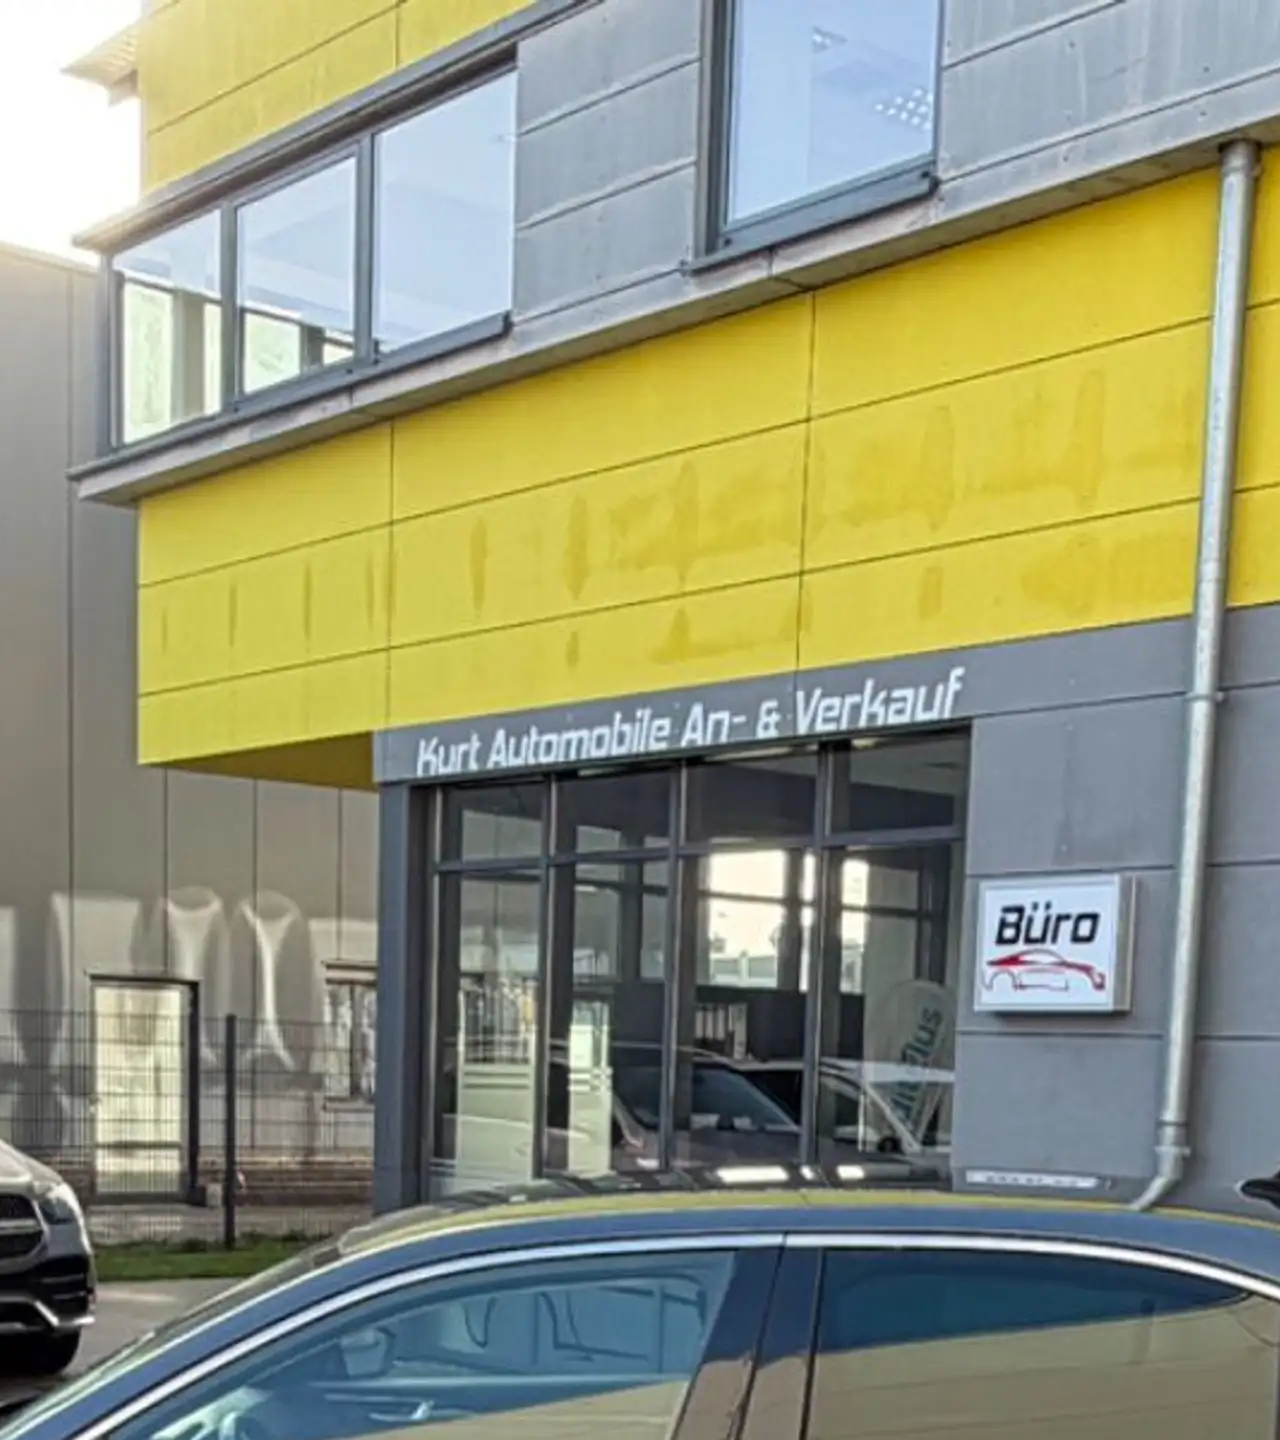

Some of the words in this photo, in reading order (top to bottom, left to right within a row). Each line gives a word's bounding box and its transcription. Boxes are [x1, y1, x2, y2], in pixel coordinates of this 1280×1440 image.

[416, 735, 482, 777] Kurt
[485, 704, 671, 768] Automobile
[680, 701, 747, 748] An-
[755, 699, 782, 738] &
[796, 667, 965, 735] Verkauf
[994, 901, 1100, 945] Büro
